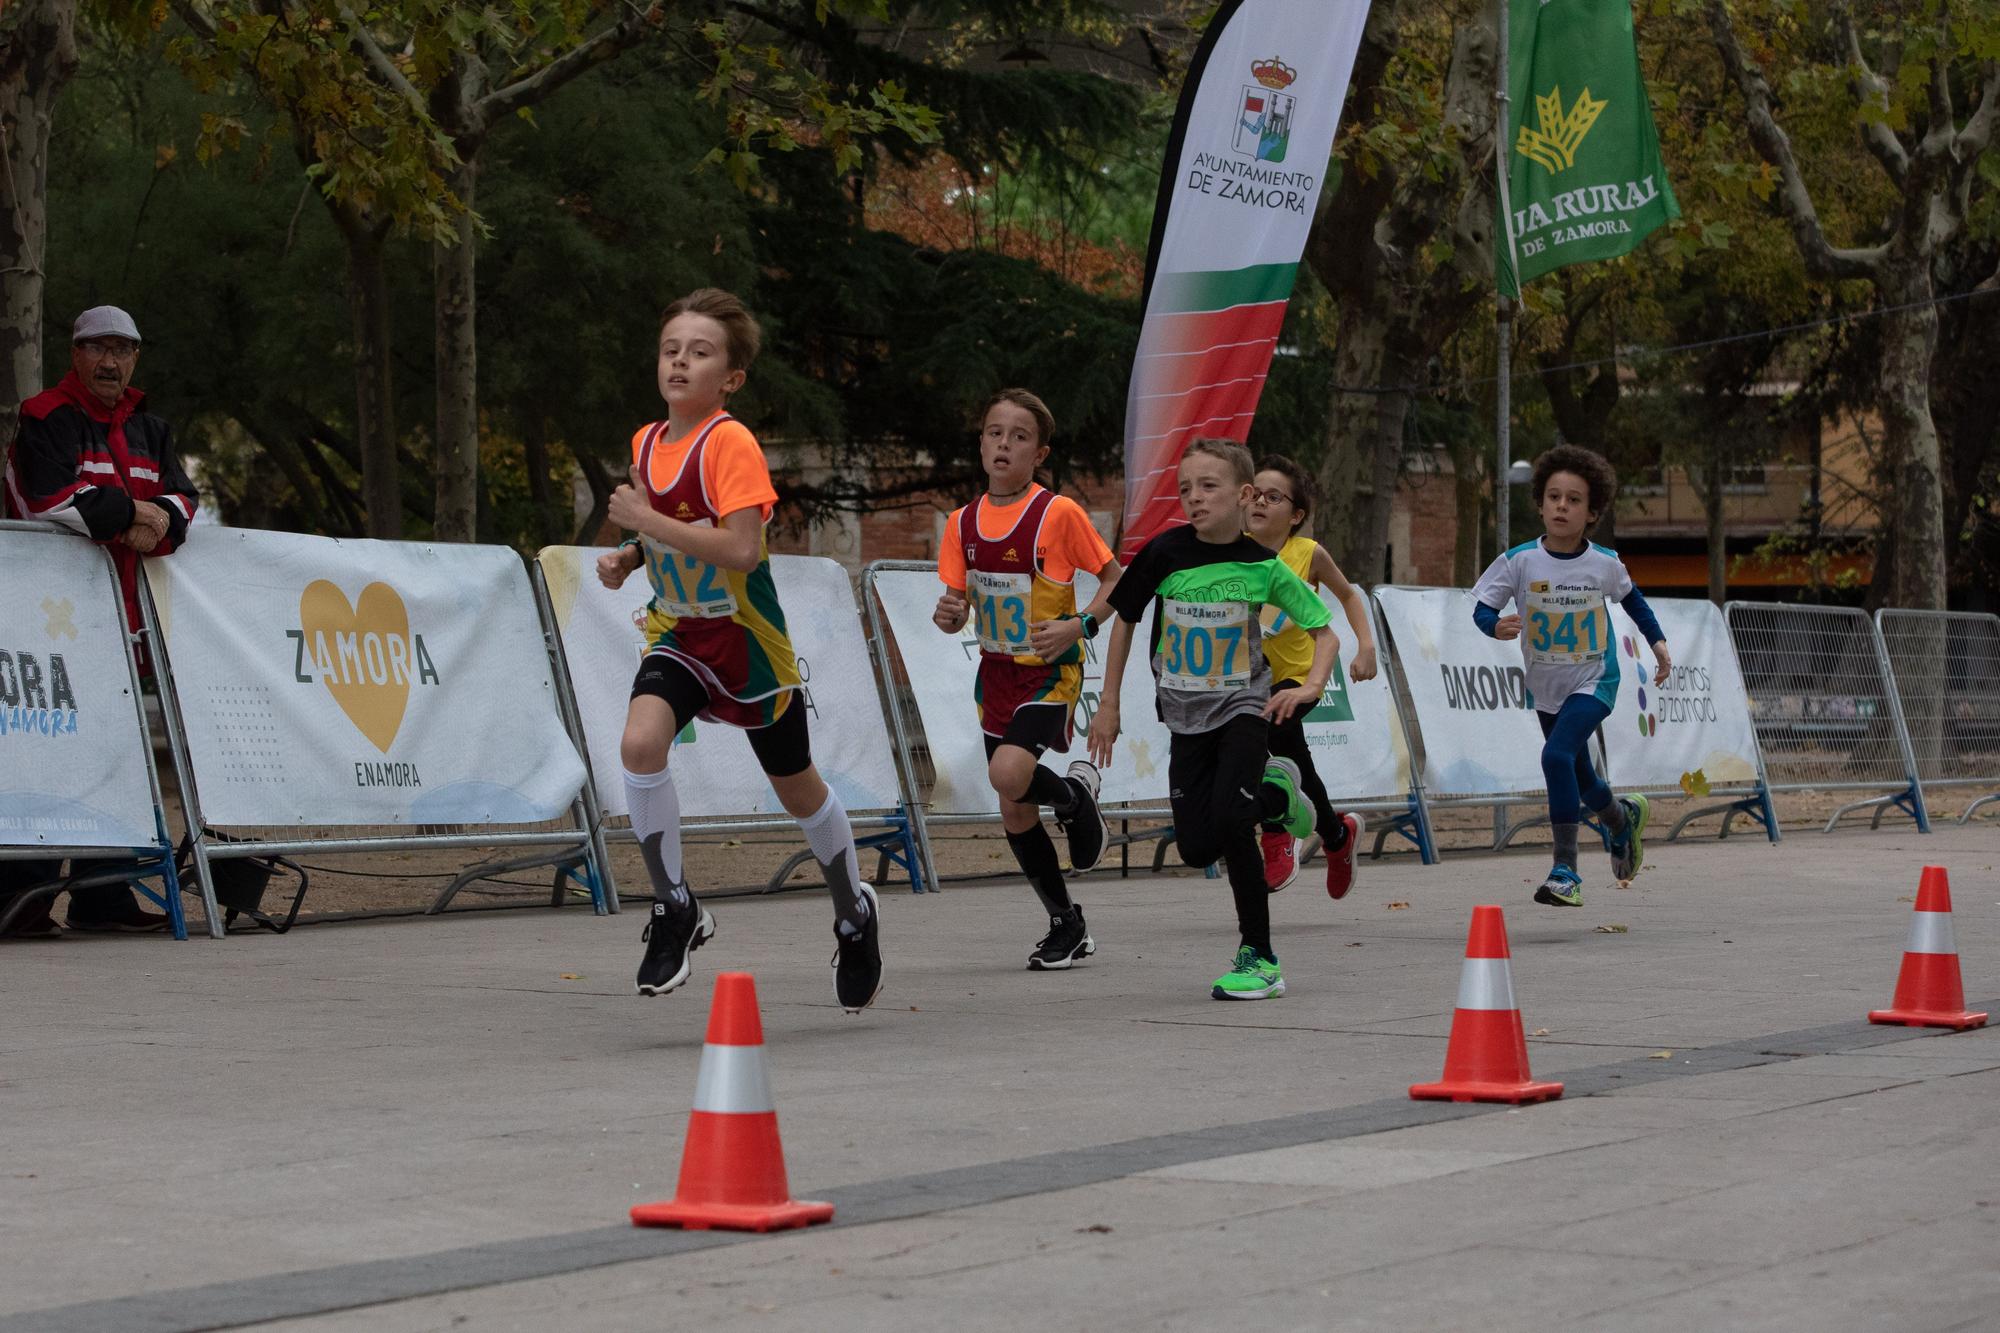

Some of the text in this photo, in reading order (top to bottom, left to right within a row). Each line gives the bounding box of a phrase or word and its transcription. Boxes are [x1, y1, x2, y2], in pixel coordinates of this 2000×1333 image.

[1188, 171, 1305, 215] DE ZAMORA
[1193, 152, 1313, 191] AYUNTAMIENTO
[1552, 174, 1659, 222] RURAL
[1521, 219, 1632, 258] DE ZAMORA
[1167, 623, 1243, 677] 307
[1531, 610, 1597, 652] 341
[286, 630, 439, 685] ZAMORA
[355, 763, 421, 787] ENAMORA
